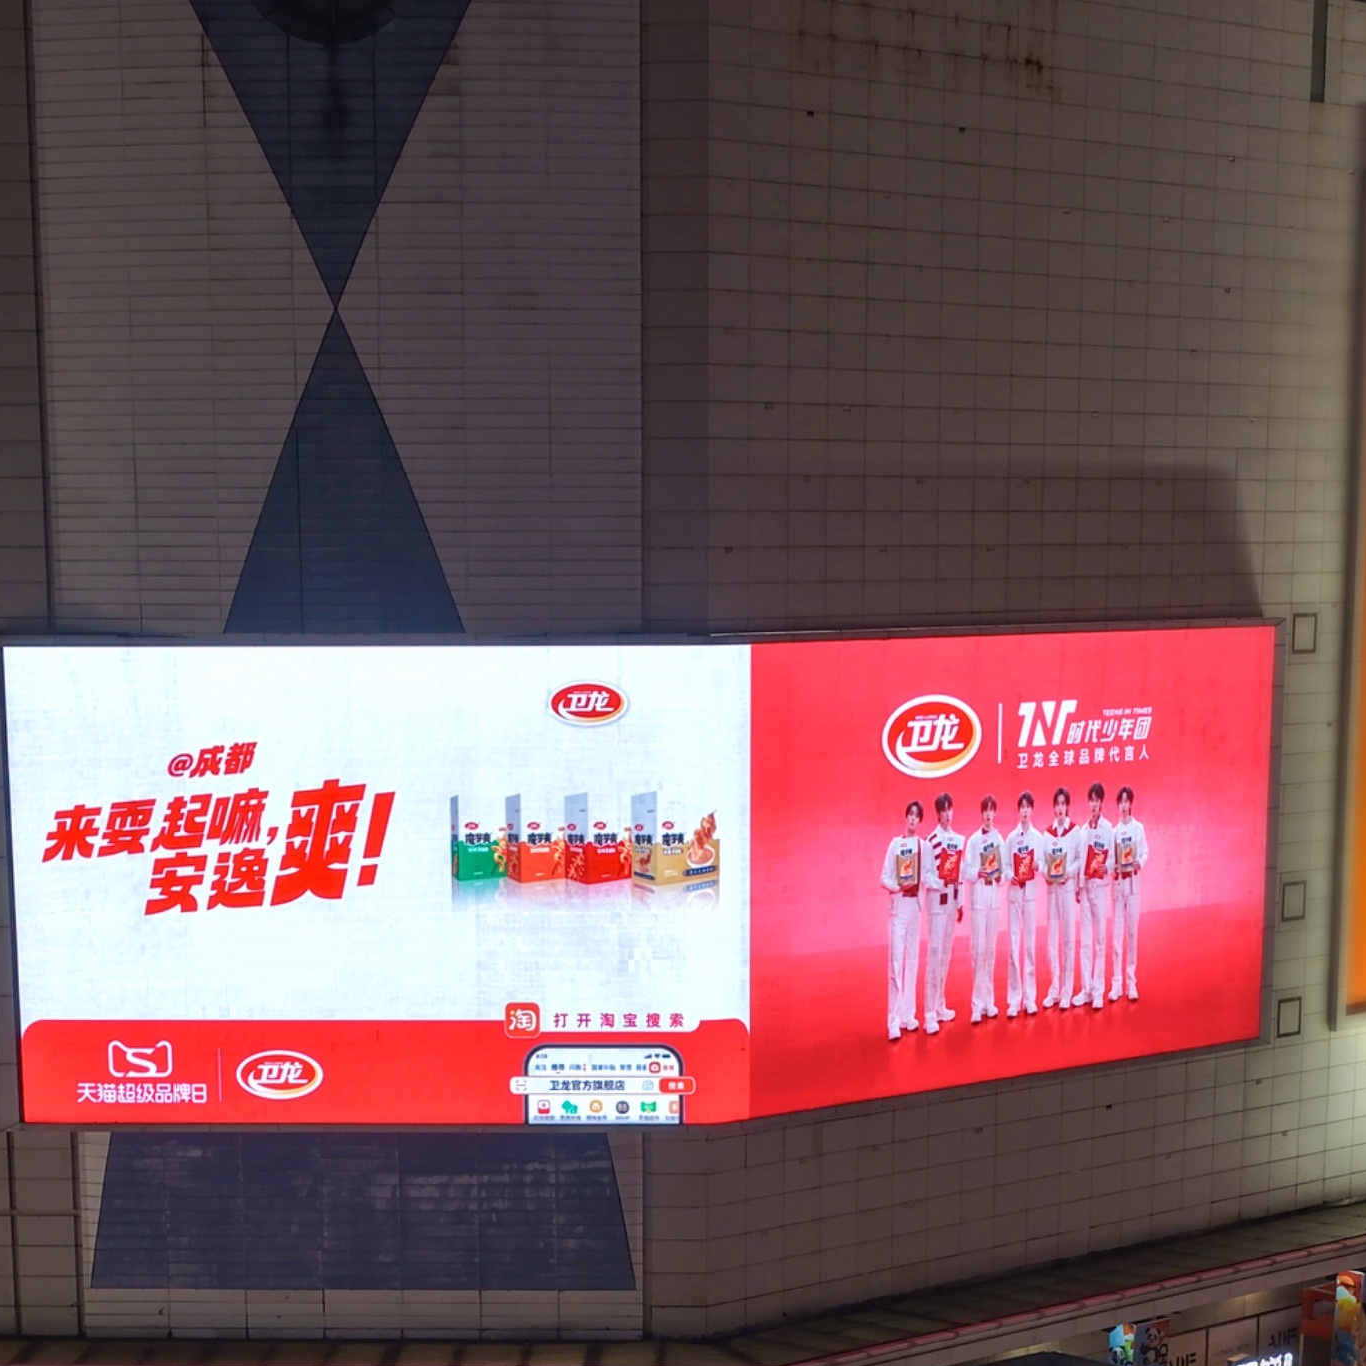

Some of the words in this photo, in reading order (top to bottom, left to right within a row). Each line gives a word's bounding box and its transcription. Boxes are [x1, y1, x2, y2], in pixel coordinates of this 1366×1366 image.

[566, 690, 615, 712] 卫龙
[905, 713, 965, 753] 卫龙
[1067, 716, 1153, 745] 时代少年团
[167, 742, 258, 778] @成都
[1017, 744, 1150, 769] 卫龙全球品牌代言人
[144, 847, 271, 916] 安逸
[509, 1010, 537, 1032] 淘
[553, 1012, 684, 1028] 打开淘宝搜索
[257, 1062, 309, 1085] 卫龙
[76, 1083, 208, 1104] 天猫超级品牌日
[549, 1080, 625, 1091] 卫龙官方旗舰店
